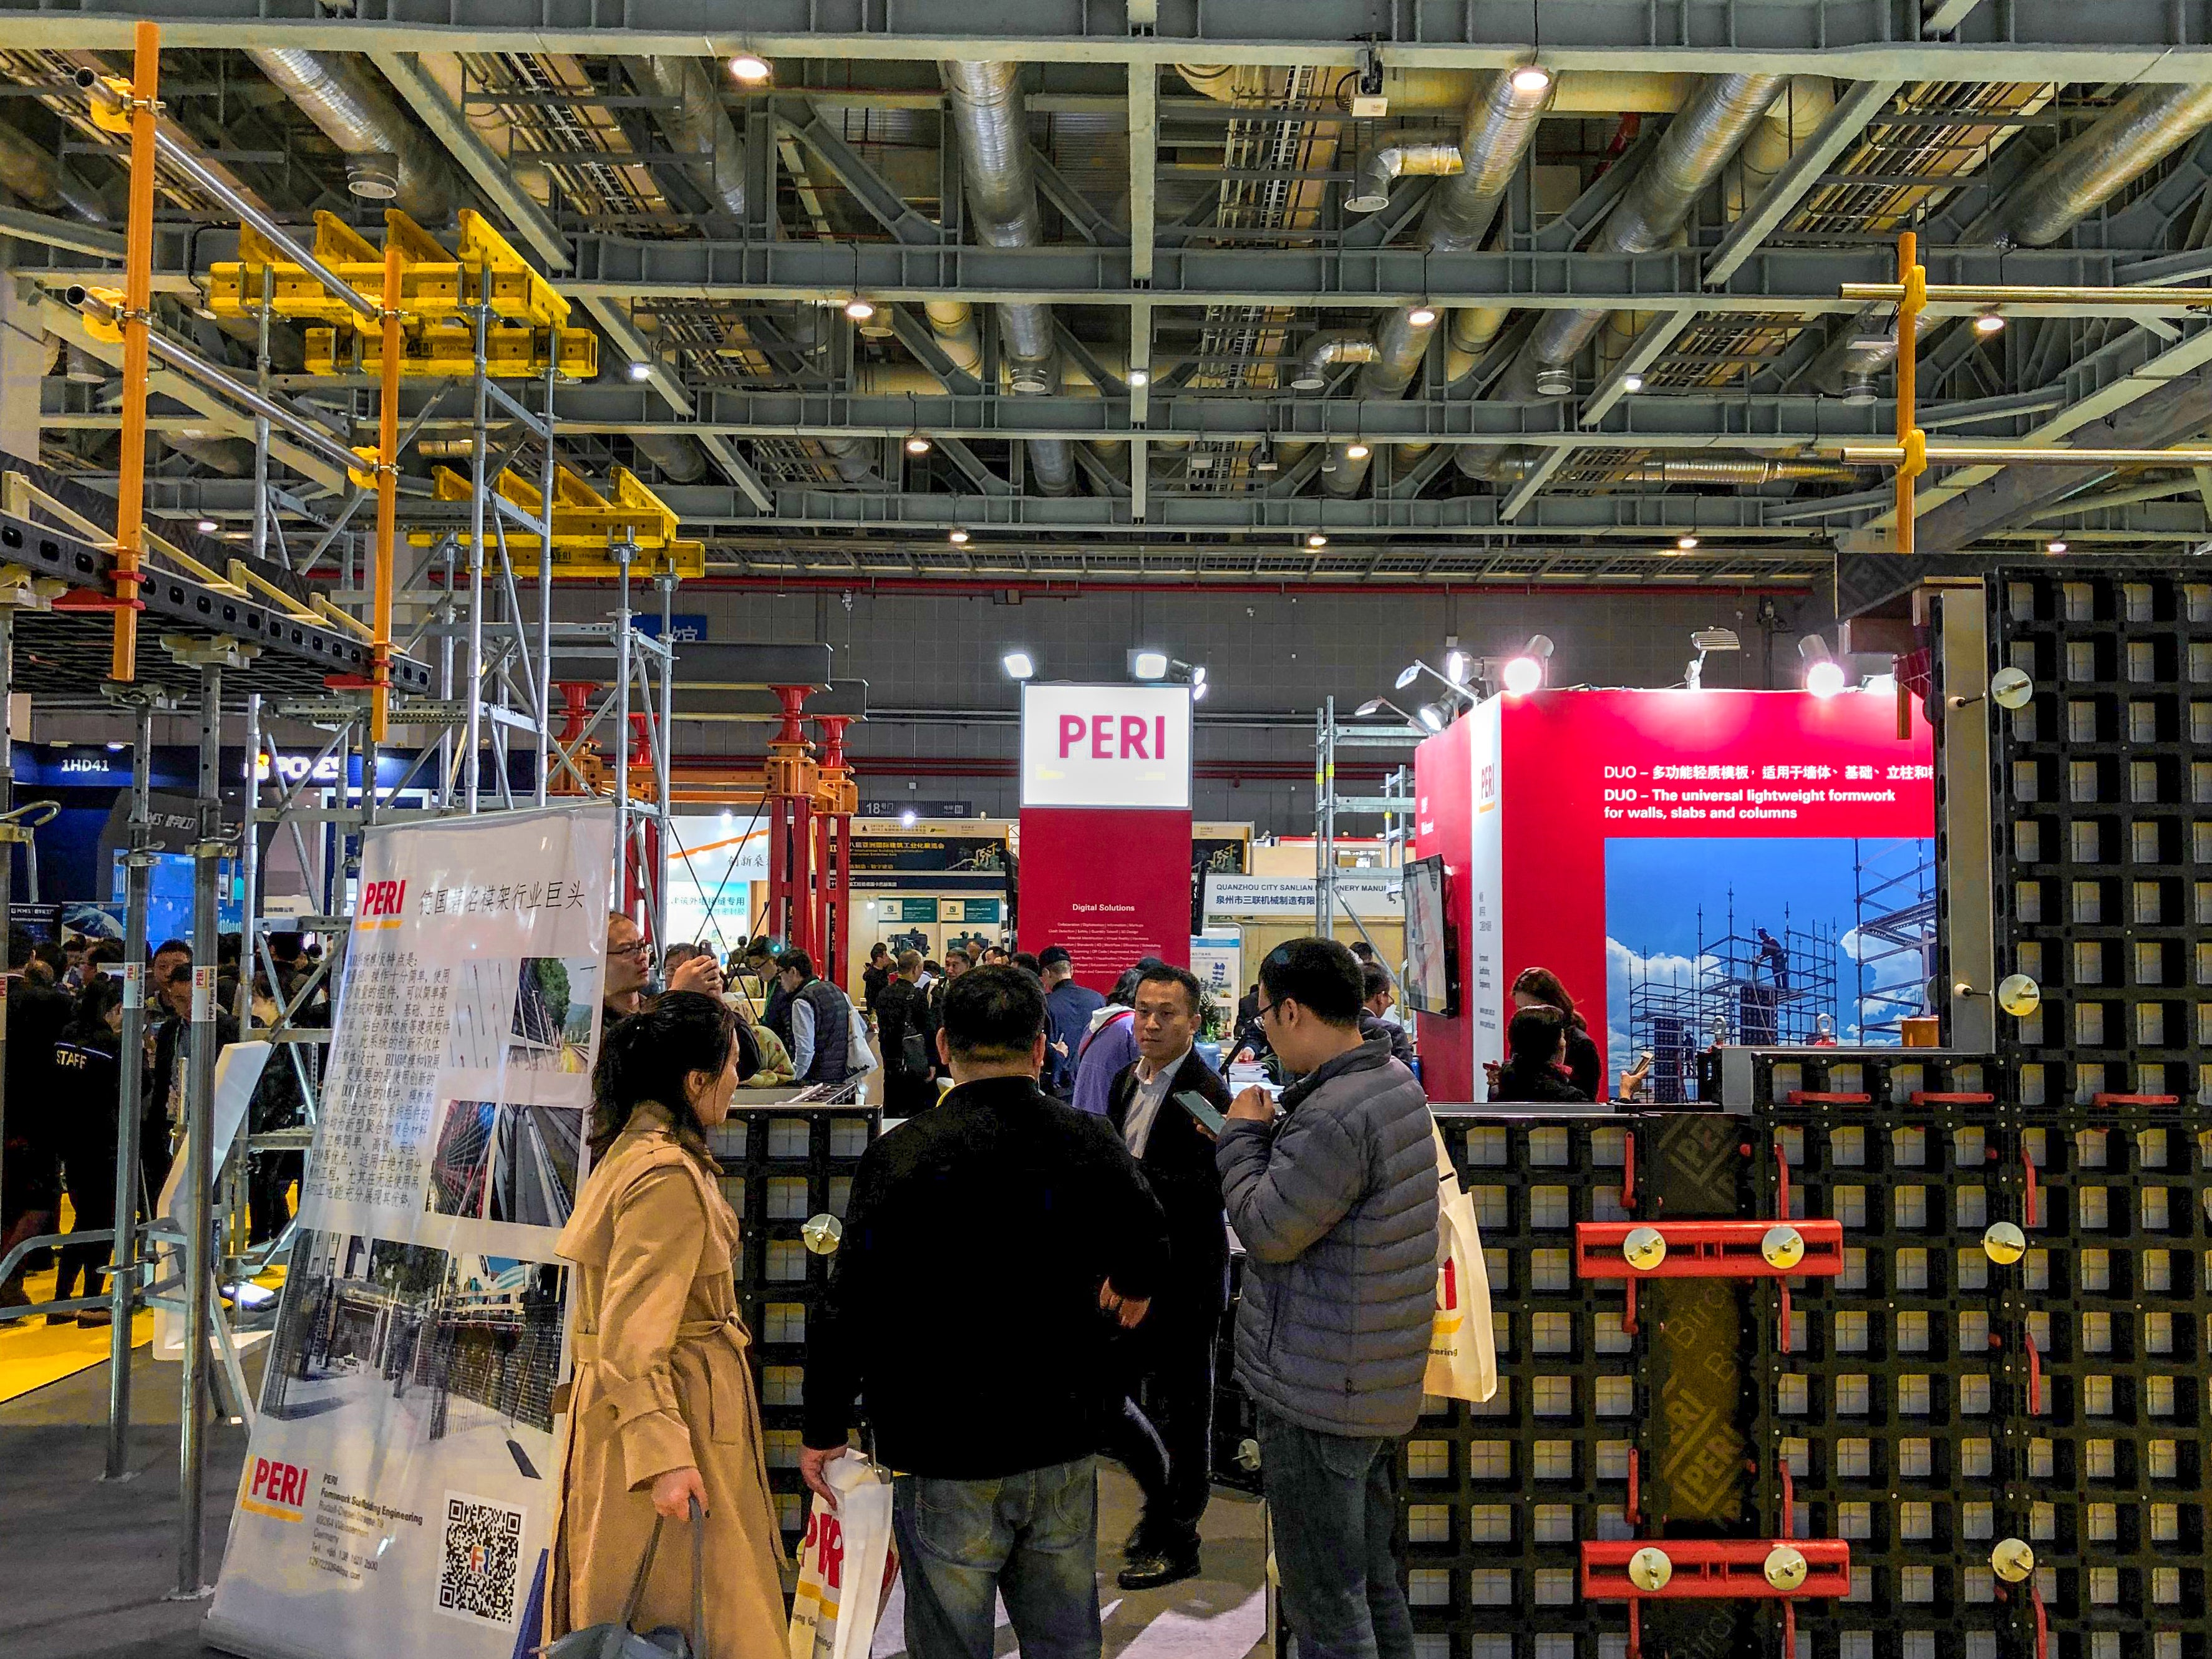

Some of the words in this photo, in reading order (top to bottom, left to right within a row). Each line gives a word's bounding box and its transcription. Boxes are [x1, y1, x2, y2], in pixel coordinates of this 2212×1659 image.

[1059, 714, 1165, 760] PERI
[61, 759, 110, 772] 1HD41
[1604, 766, 1637, 779] DUO
[1481, 763, 1495, 800] PERI
[1604, 789, 1637, 802] DUO
[1652, 789, 1678, 802] The
[1681, 789, 1743, 802] universal
[1747, 789, 1825, 805] lightweight
[1828, 789, 1896, 802] formwork
[866, 803, 881, 815] 18
[1604, 806, 1624, 819] for
[1627, 806, 1667, 821] walls,
[1671, 806, 1707, 819] slabs
[1709, 806, 1735, 819] and
[1738, 806, 1797, 819] columns
[362, 879, 407, 916] PERI
[1072, 904, 1097, 912] Digital
[1099, 904, 1135, 912] Solutions
[56, 1050, 87, 1070] STAFF
[252, 1457, 309, 1507] PERI
[323, 1472, 339, 1486] PERI
[382, 1505, 423, 1526] Engineering
